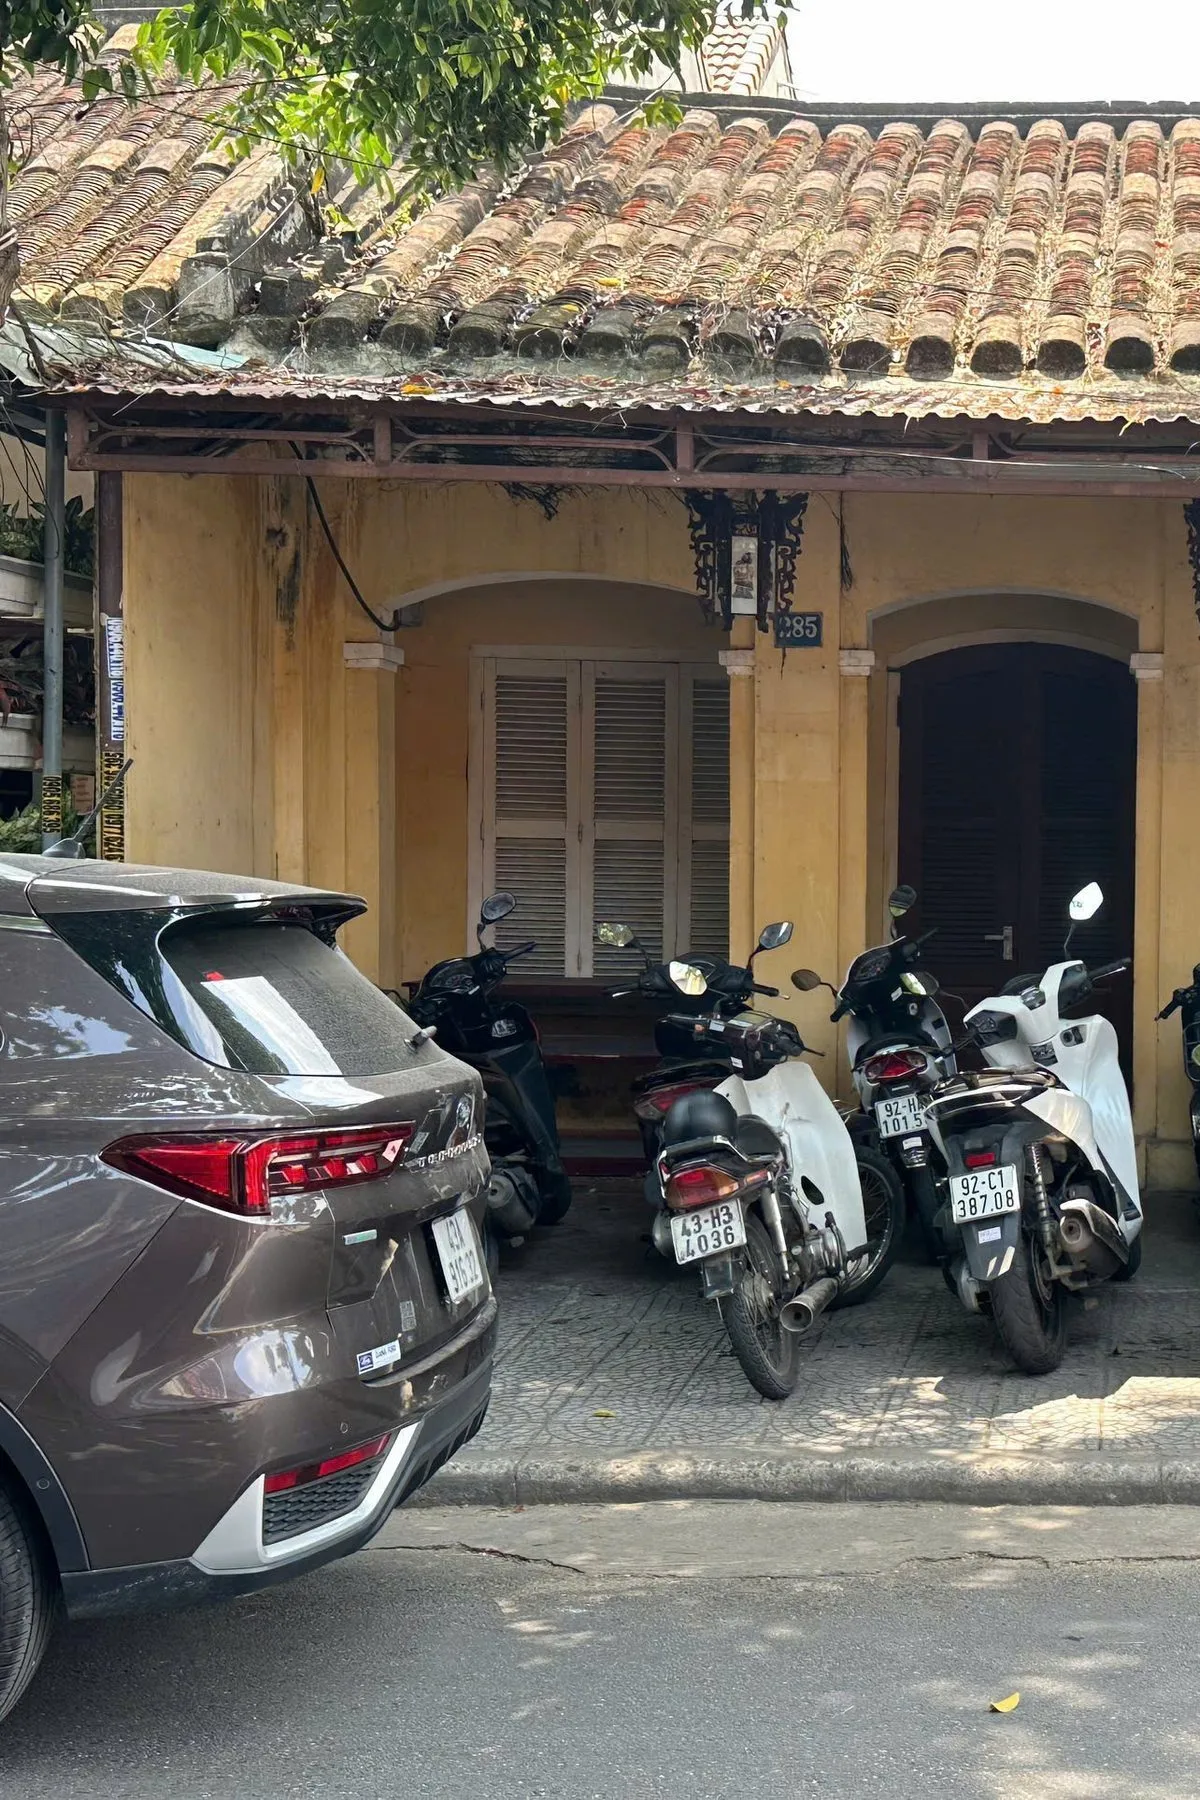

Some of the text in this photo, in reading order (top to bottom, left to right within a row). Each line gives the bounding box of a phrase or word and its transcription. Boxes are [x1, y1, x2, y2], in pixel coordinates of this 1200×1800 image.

[961, 1170, 1004, 1196] 92-C1
[957, 1189, 1014, 1218] 387.08
[681, 1205, 733, 1237] 43-H3
[685, 1225, 735, 1258] 4036
